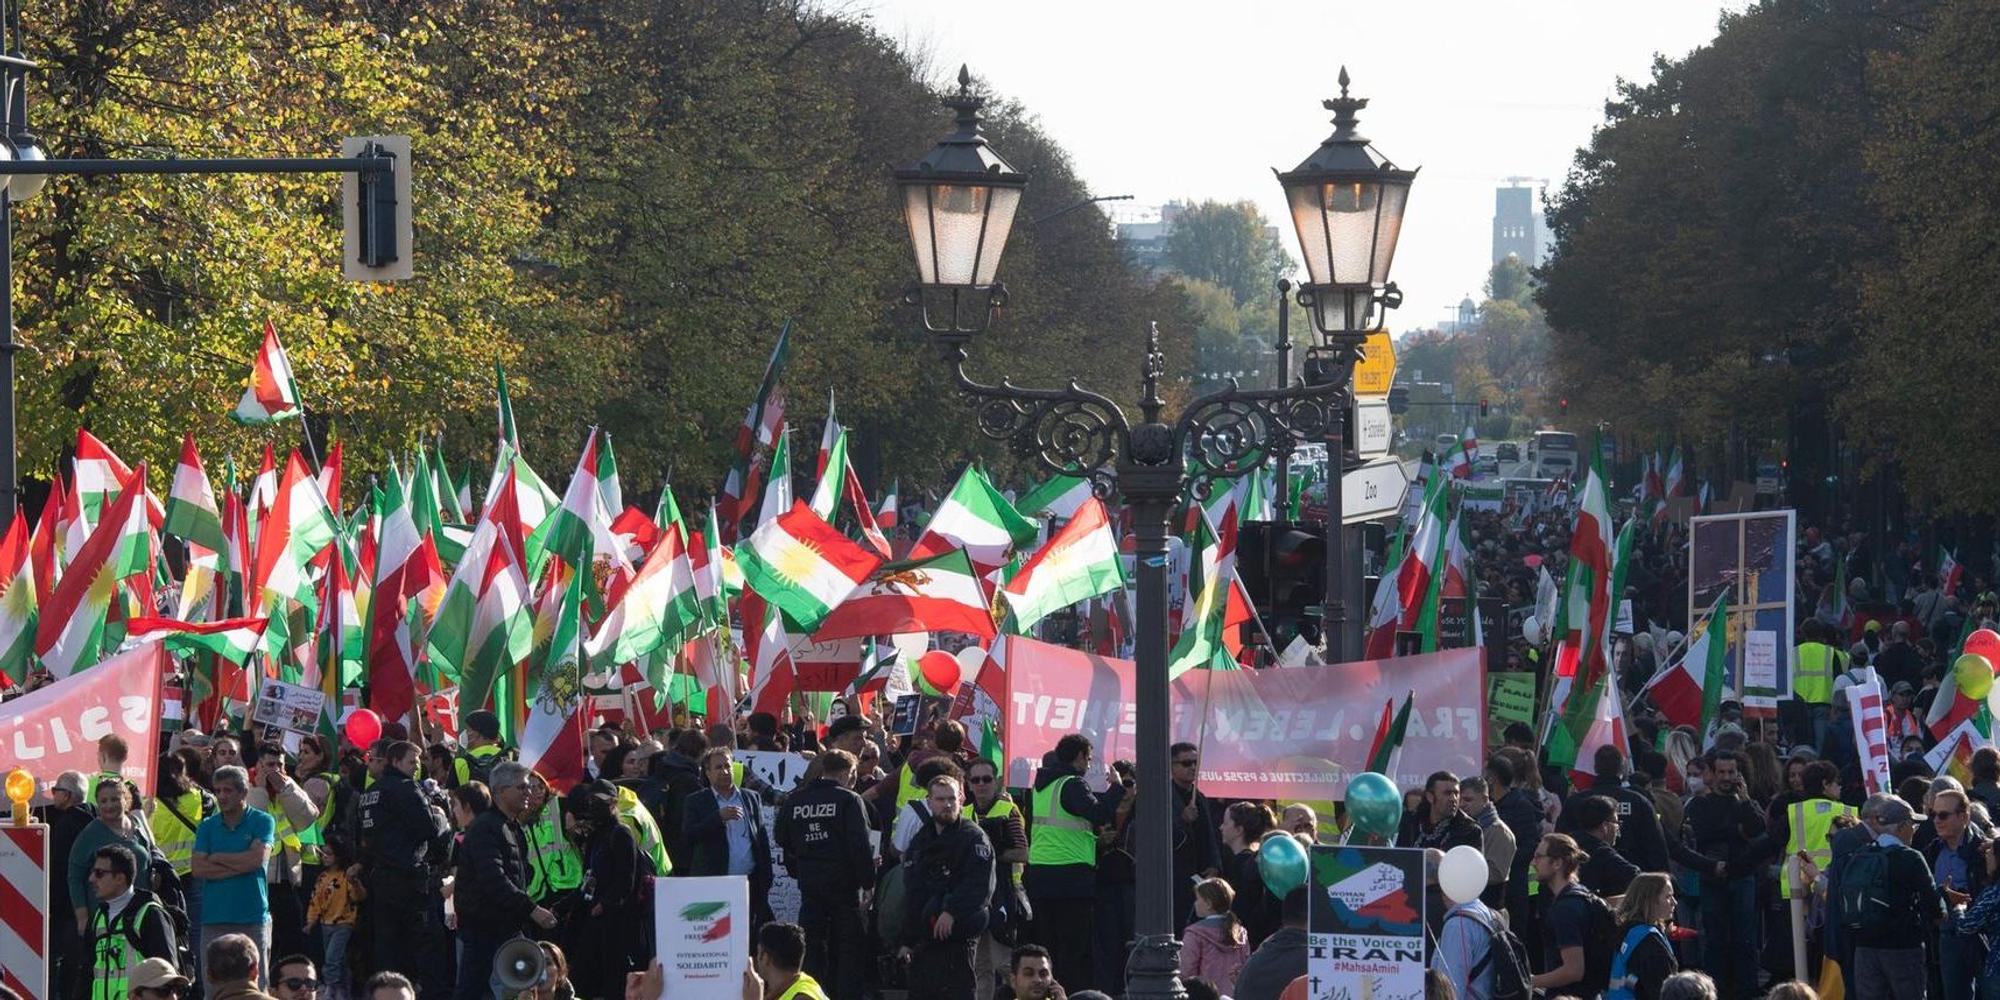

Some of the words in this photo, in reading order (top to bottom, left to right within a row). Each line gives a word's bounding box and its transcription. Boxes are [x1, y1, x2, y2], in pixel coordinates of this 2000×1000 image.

[1365, 481, 1378, 500] Zoo
[793, 803, 836, 819] POLIZEI
[1330, 890, 1366, 898] WOMAN
[1309, 935, 1327, 945] Be
[1333, 936, 1356, 947] the
[1361, 938, 1402, 948] Voice
[1407, 939, 1422, 949] of
[1309, 946, 1422, 962] IRAN
[676, 961, 729, 970] SOLIDARITY
[1334, 961, 1400, 974] #MahsaAmini
